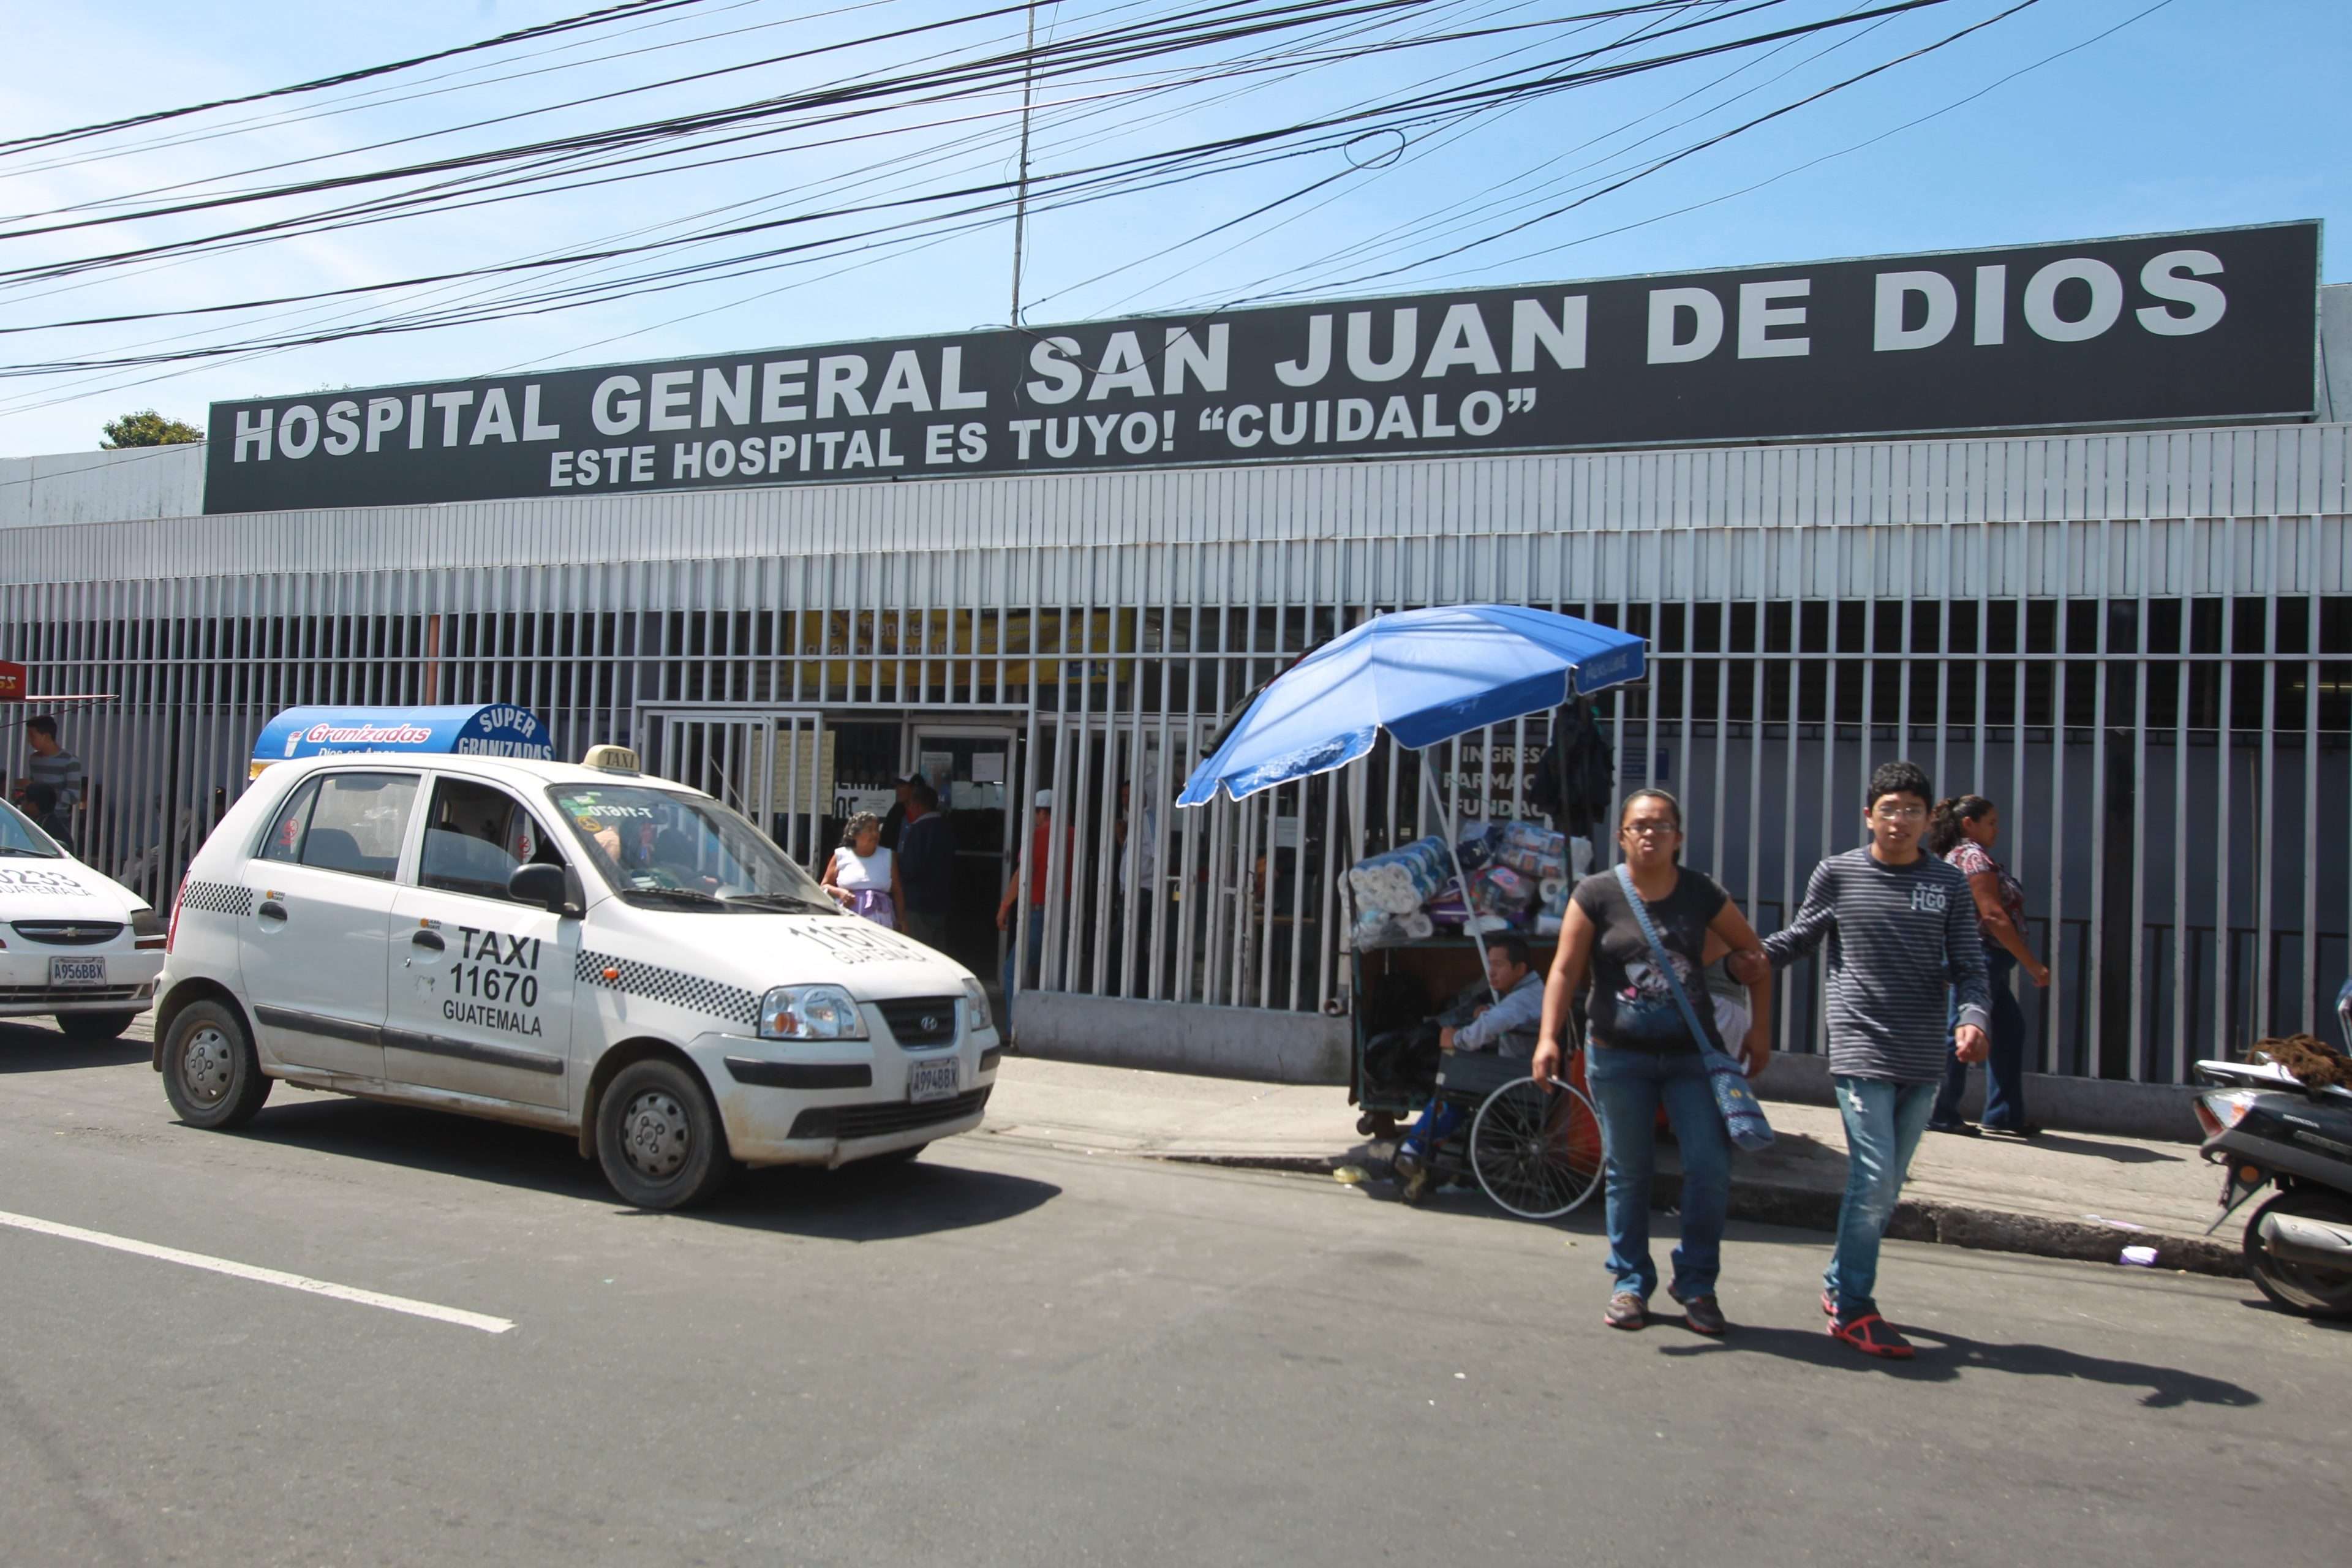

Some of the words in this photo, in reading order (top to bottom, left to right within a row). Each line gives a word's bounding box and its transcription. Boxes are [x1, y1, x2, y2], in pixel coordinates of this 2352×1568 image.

[234, 384, 560, 464] HOSPITAL
[592, 345, 987, 436] GENERAL
[1026, 323, 1230, 404] SAN
[1275, 295, 1588, 387] JUAN
[1647, 279, 1811, 364] DE
[1874, 249, 2226, 352] DIOS
[549, 445, 655, 487] ESTE
[673, 428, 905, 480] HOSPITAL
[925, 422, 987, 464] ES
[1009, 410, 1175, 460] TUYO!
[1199, 387, 1536, 448] “CUIDALO”
[307, 723, 431, 743] Granizadas
[479, 707, 537, 739] SUPER
[459, 737, 552, 762] GRANIZADAS
[604, 751, 635, 768] TAXI
[1443, 772, 1536, 790] FARMAC
[0, 885, 97, 897] UATEMALA
[458, 925, 541, 970] TAXI
[55, 963, 104, 979] A956BBX
[450, 962, 538, 1008] 11670
[443, 999, 542, 1038] GUATEMALA
